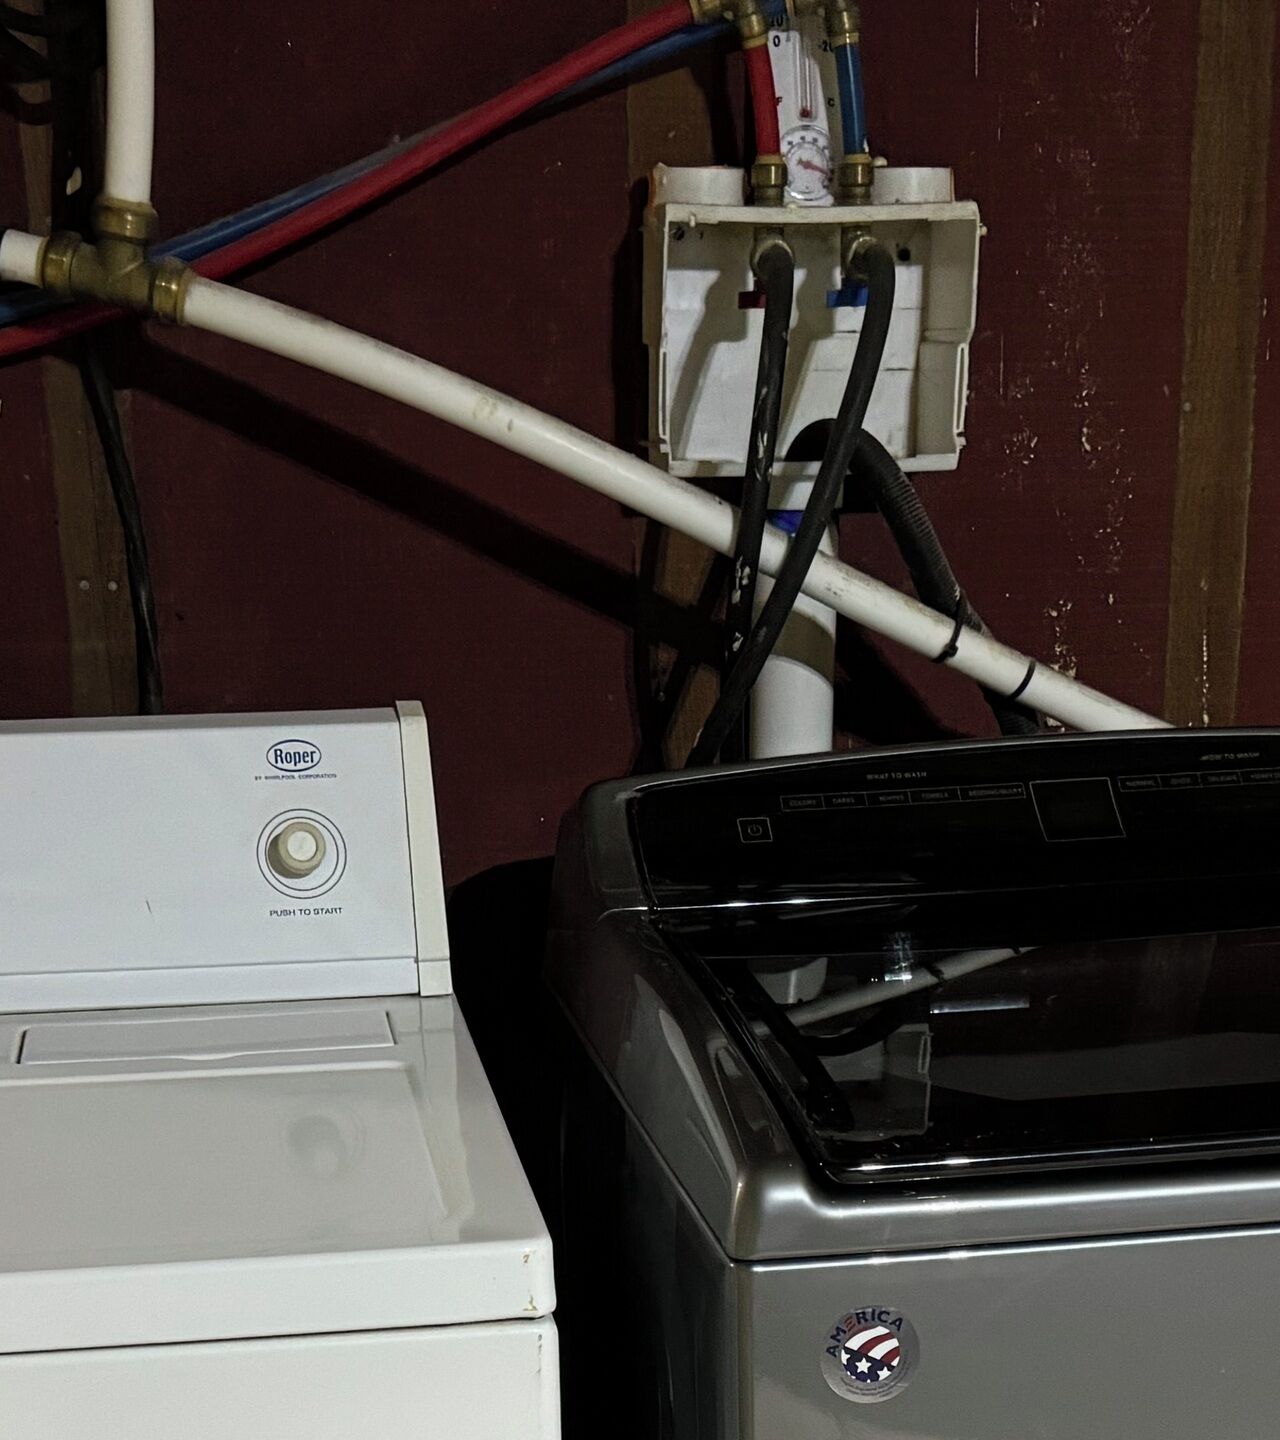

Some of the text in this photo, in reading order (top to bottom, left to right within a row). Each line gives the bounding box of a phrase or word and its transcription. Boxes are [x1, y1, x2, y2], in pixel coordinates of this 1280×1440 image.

[274, 748, 317, 767] Roper
[269, 907, 343, 917] PUSH TO START
[825, 1308, 904, 1359] AMERICA
